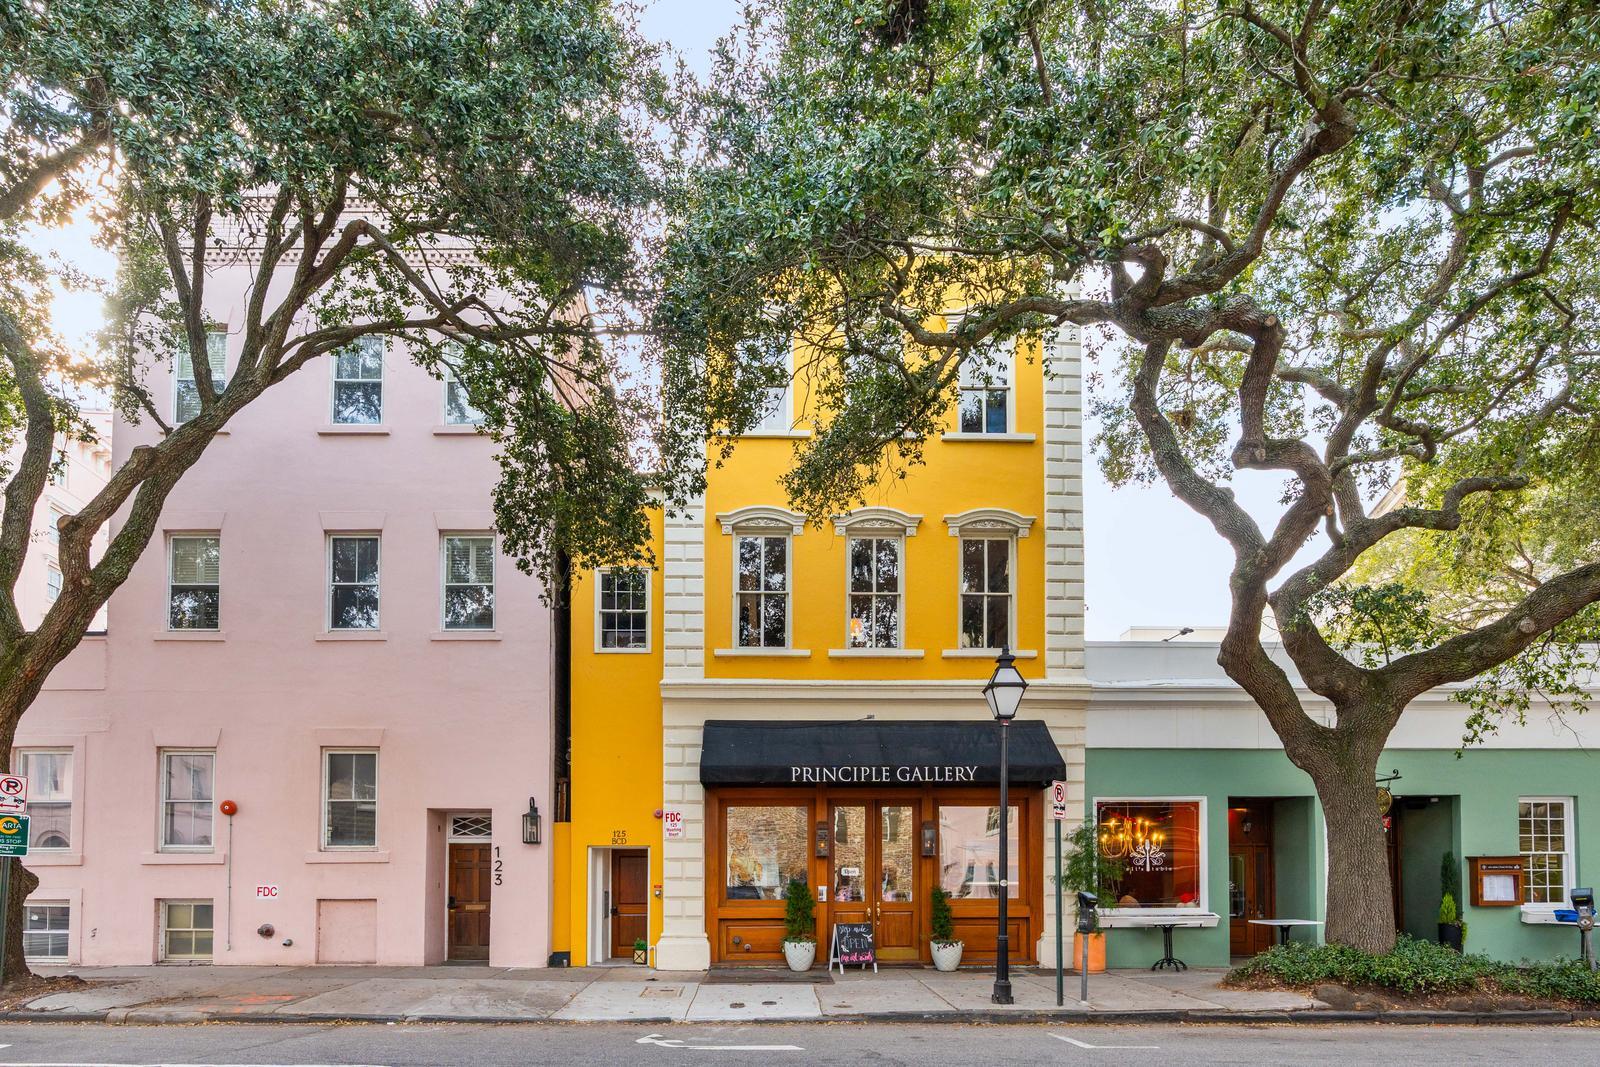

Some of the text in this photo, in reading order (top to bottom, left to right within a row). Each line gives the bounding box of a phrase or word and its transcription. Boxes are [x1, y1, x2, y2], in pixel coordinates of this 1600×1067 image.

[791, 766, 978, 782] PRINCIPLE GALLERY
[665, 812, 681, 822] FDC
[613, 830, 626, 838] 125
[494, 846, 503, 886] 123
[256, 886, 278, 897] FDC
